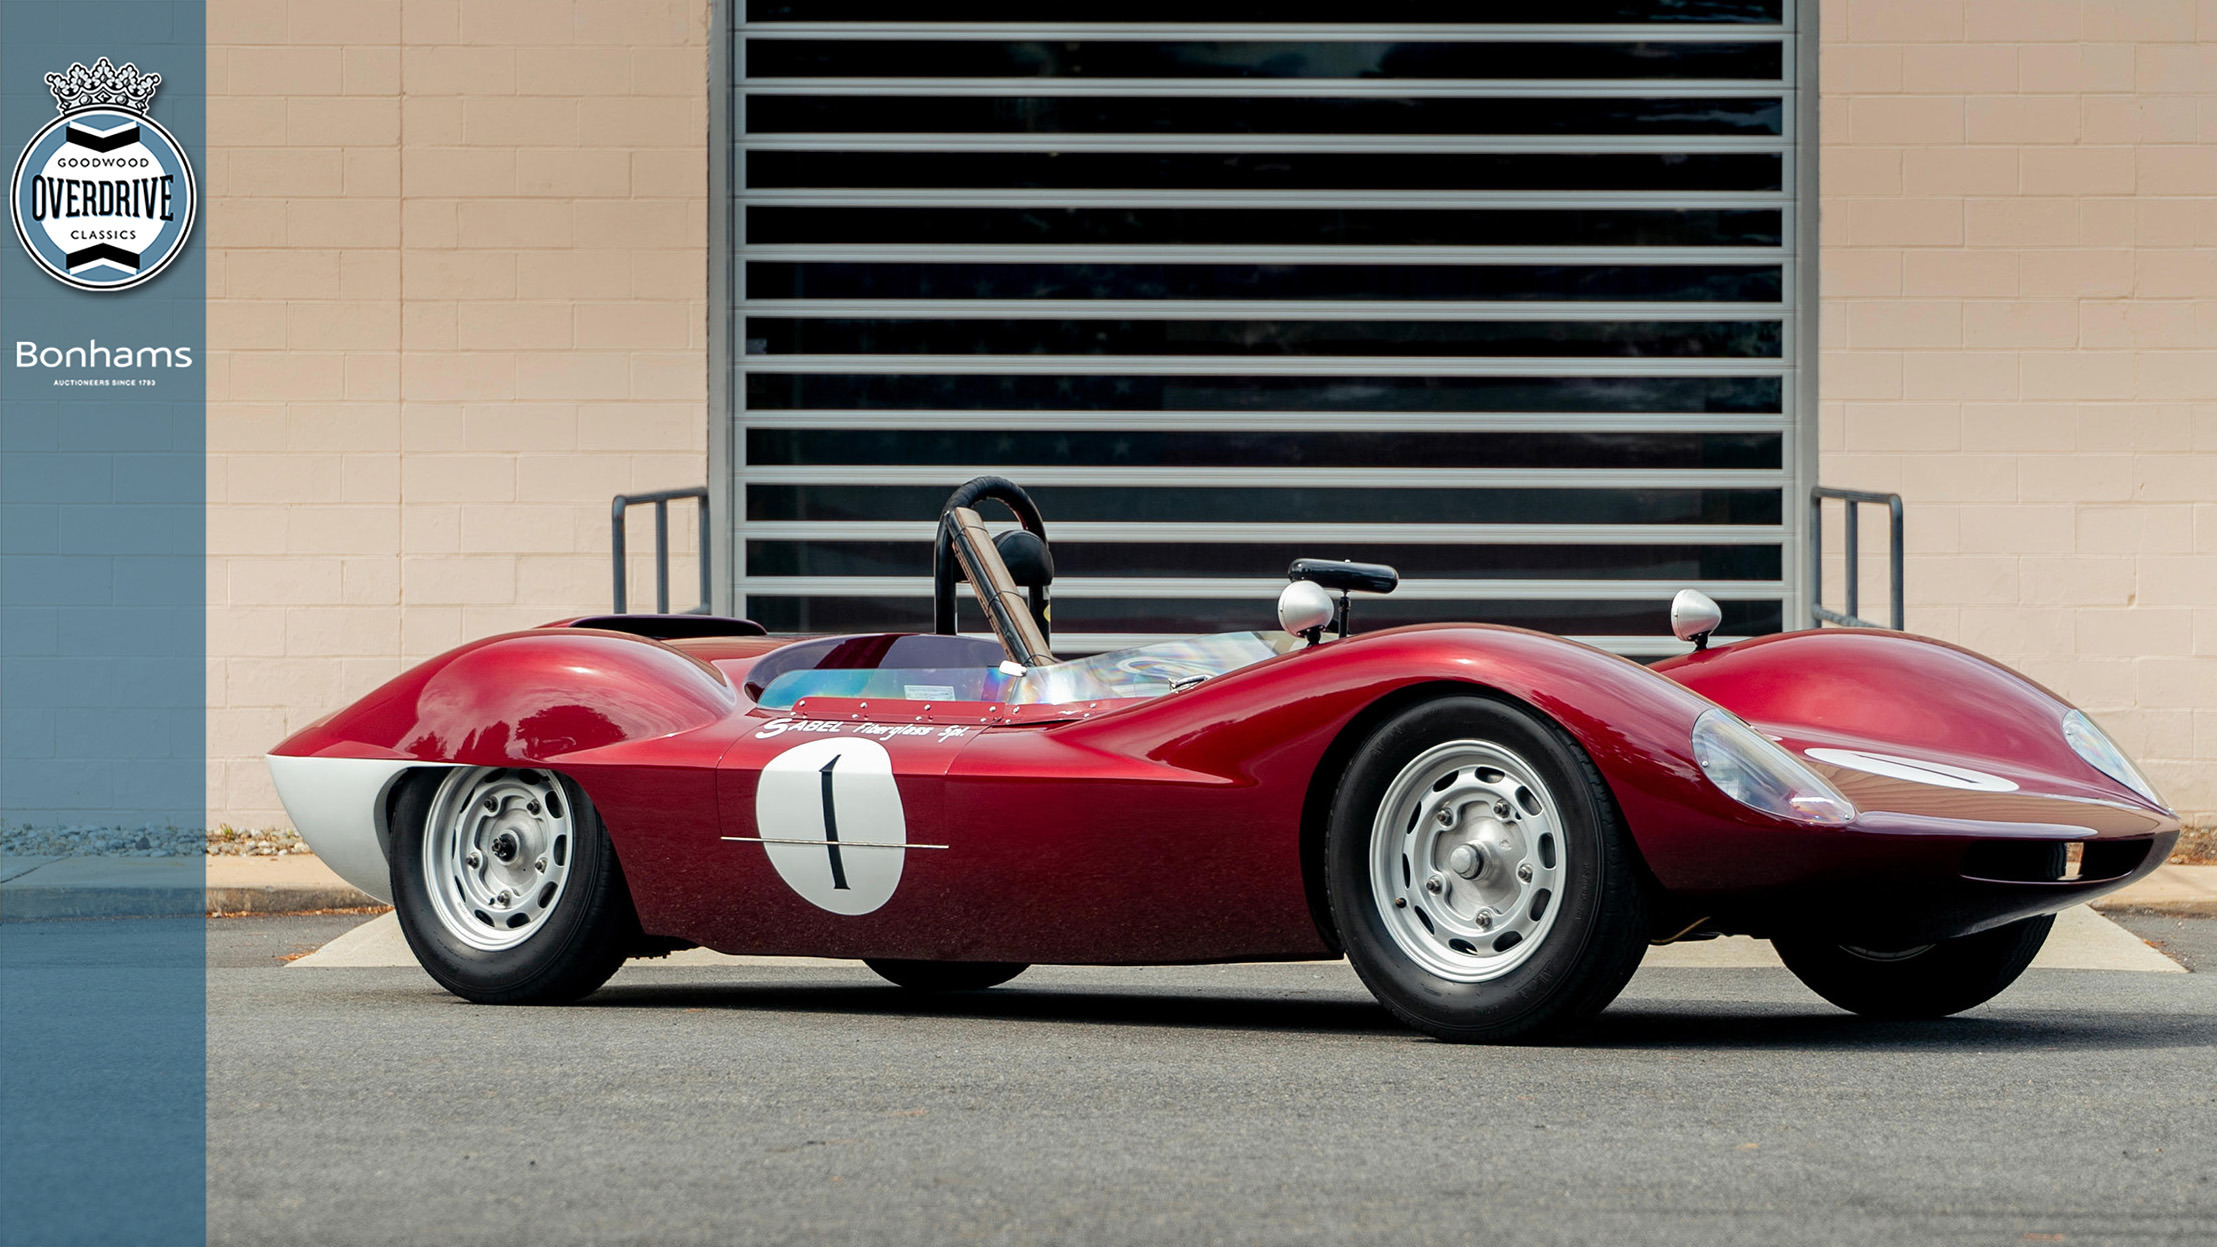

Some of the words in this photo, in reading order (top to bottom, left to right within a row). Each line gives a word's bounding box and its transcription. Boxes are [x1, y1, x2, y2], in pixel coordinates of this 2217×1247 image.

[755, 718, 844, 739] SABEL
[852, 722, 934, 741] Fiberglass
[819, 754, 851, 890] 1
